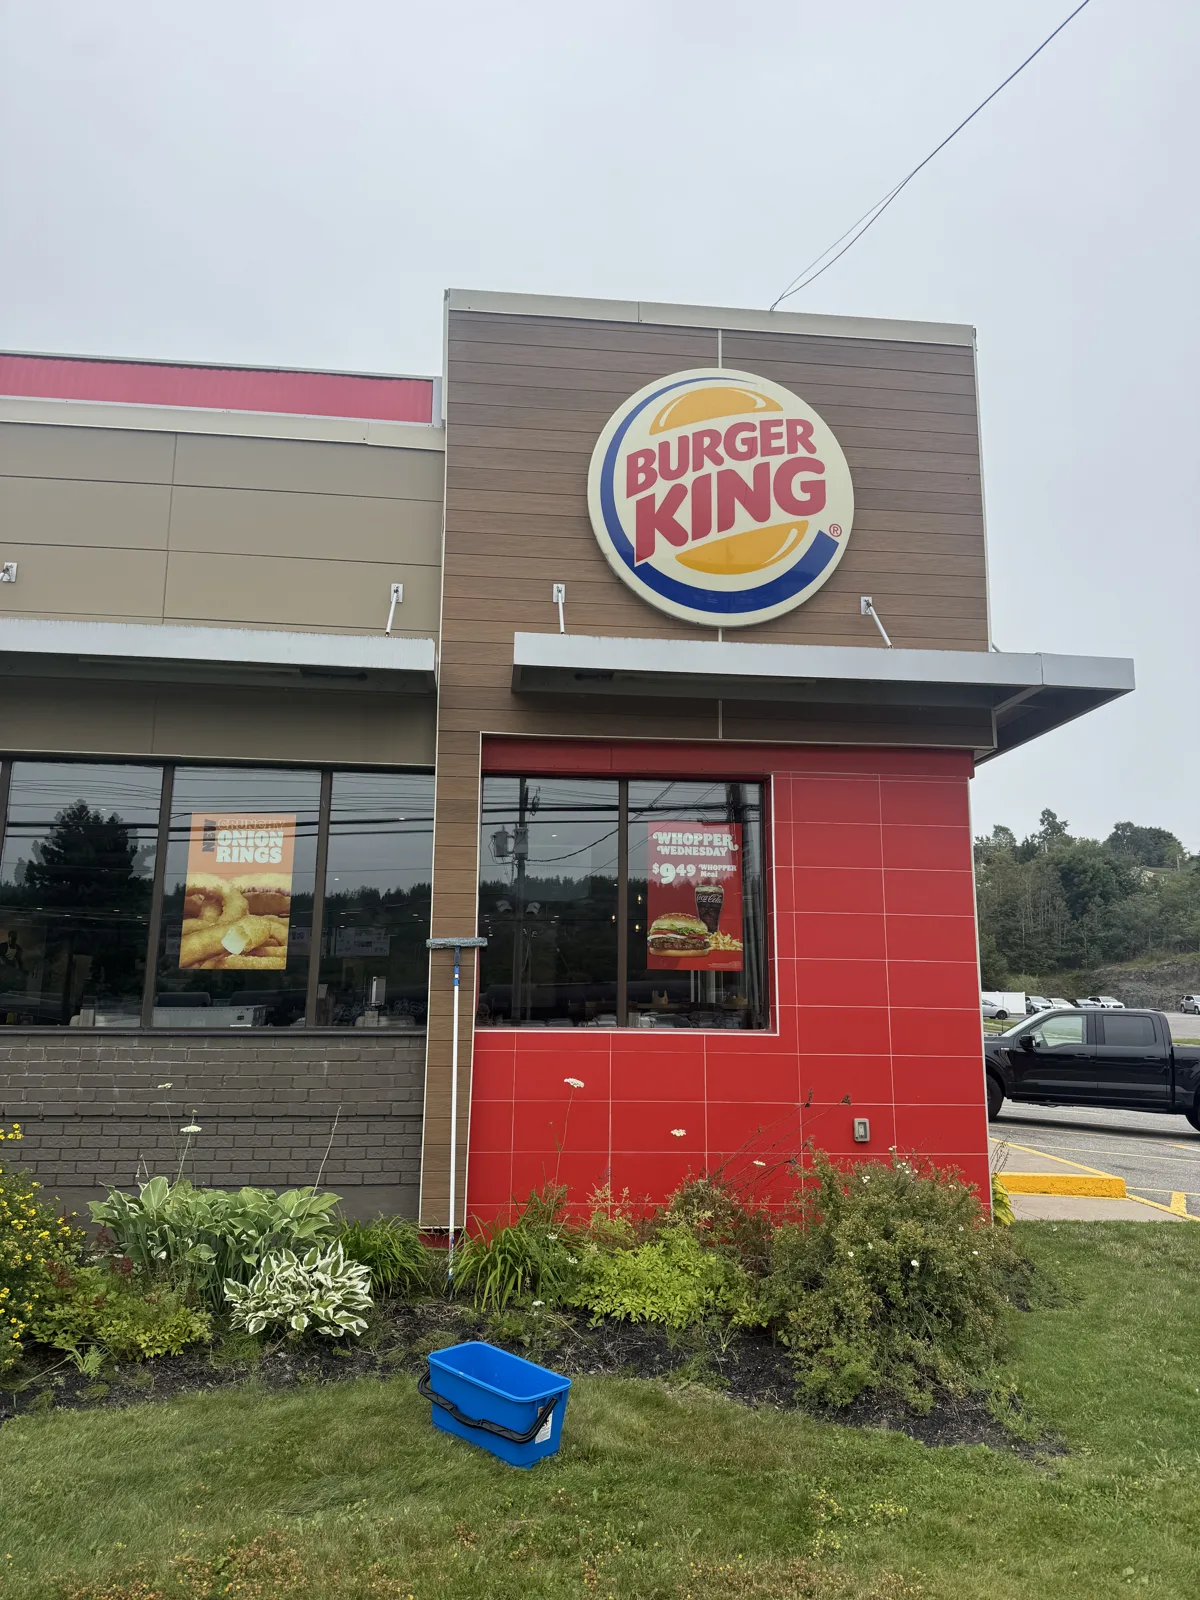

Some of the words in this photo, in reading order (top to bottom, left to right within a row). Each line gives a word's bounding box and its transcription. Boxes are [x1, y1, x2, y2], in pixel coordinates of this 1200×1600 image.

[626, 418, 817, 499] BURGER
[635, 456, 826, 564] KING
[218, 819, 285, 831] CRUNCHY
[202, 819, 216, 852] NEW
[217, 830, 284, 847] ONION
[652, 831, 739, 851] WHOPPER
[216, 846, 282, 864] RINGS
[656, 845, 728, 856] WEDNESDAY
